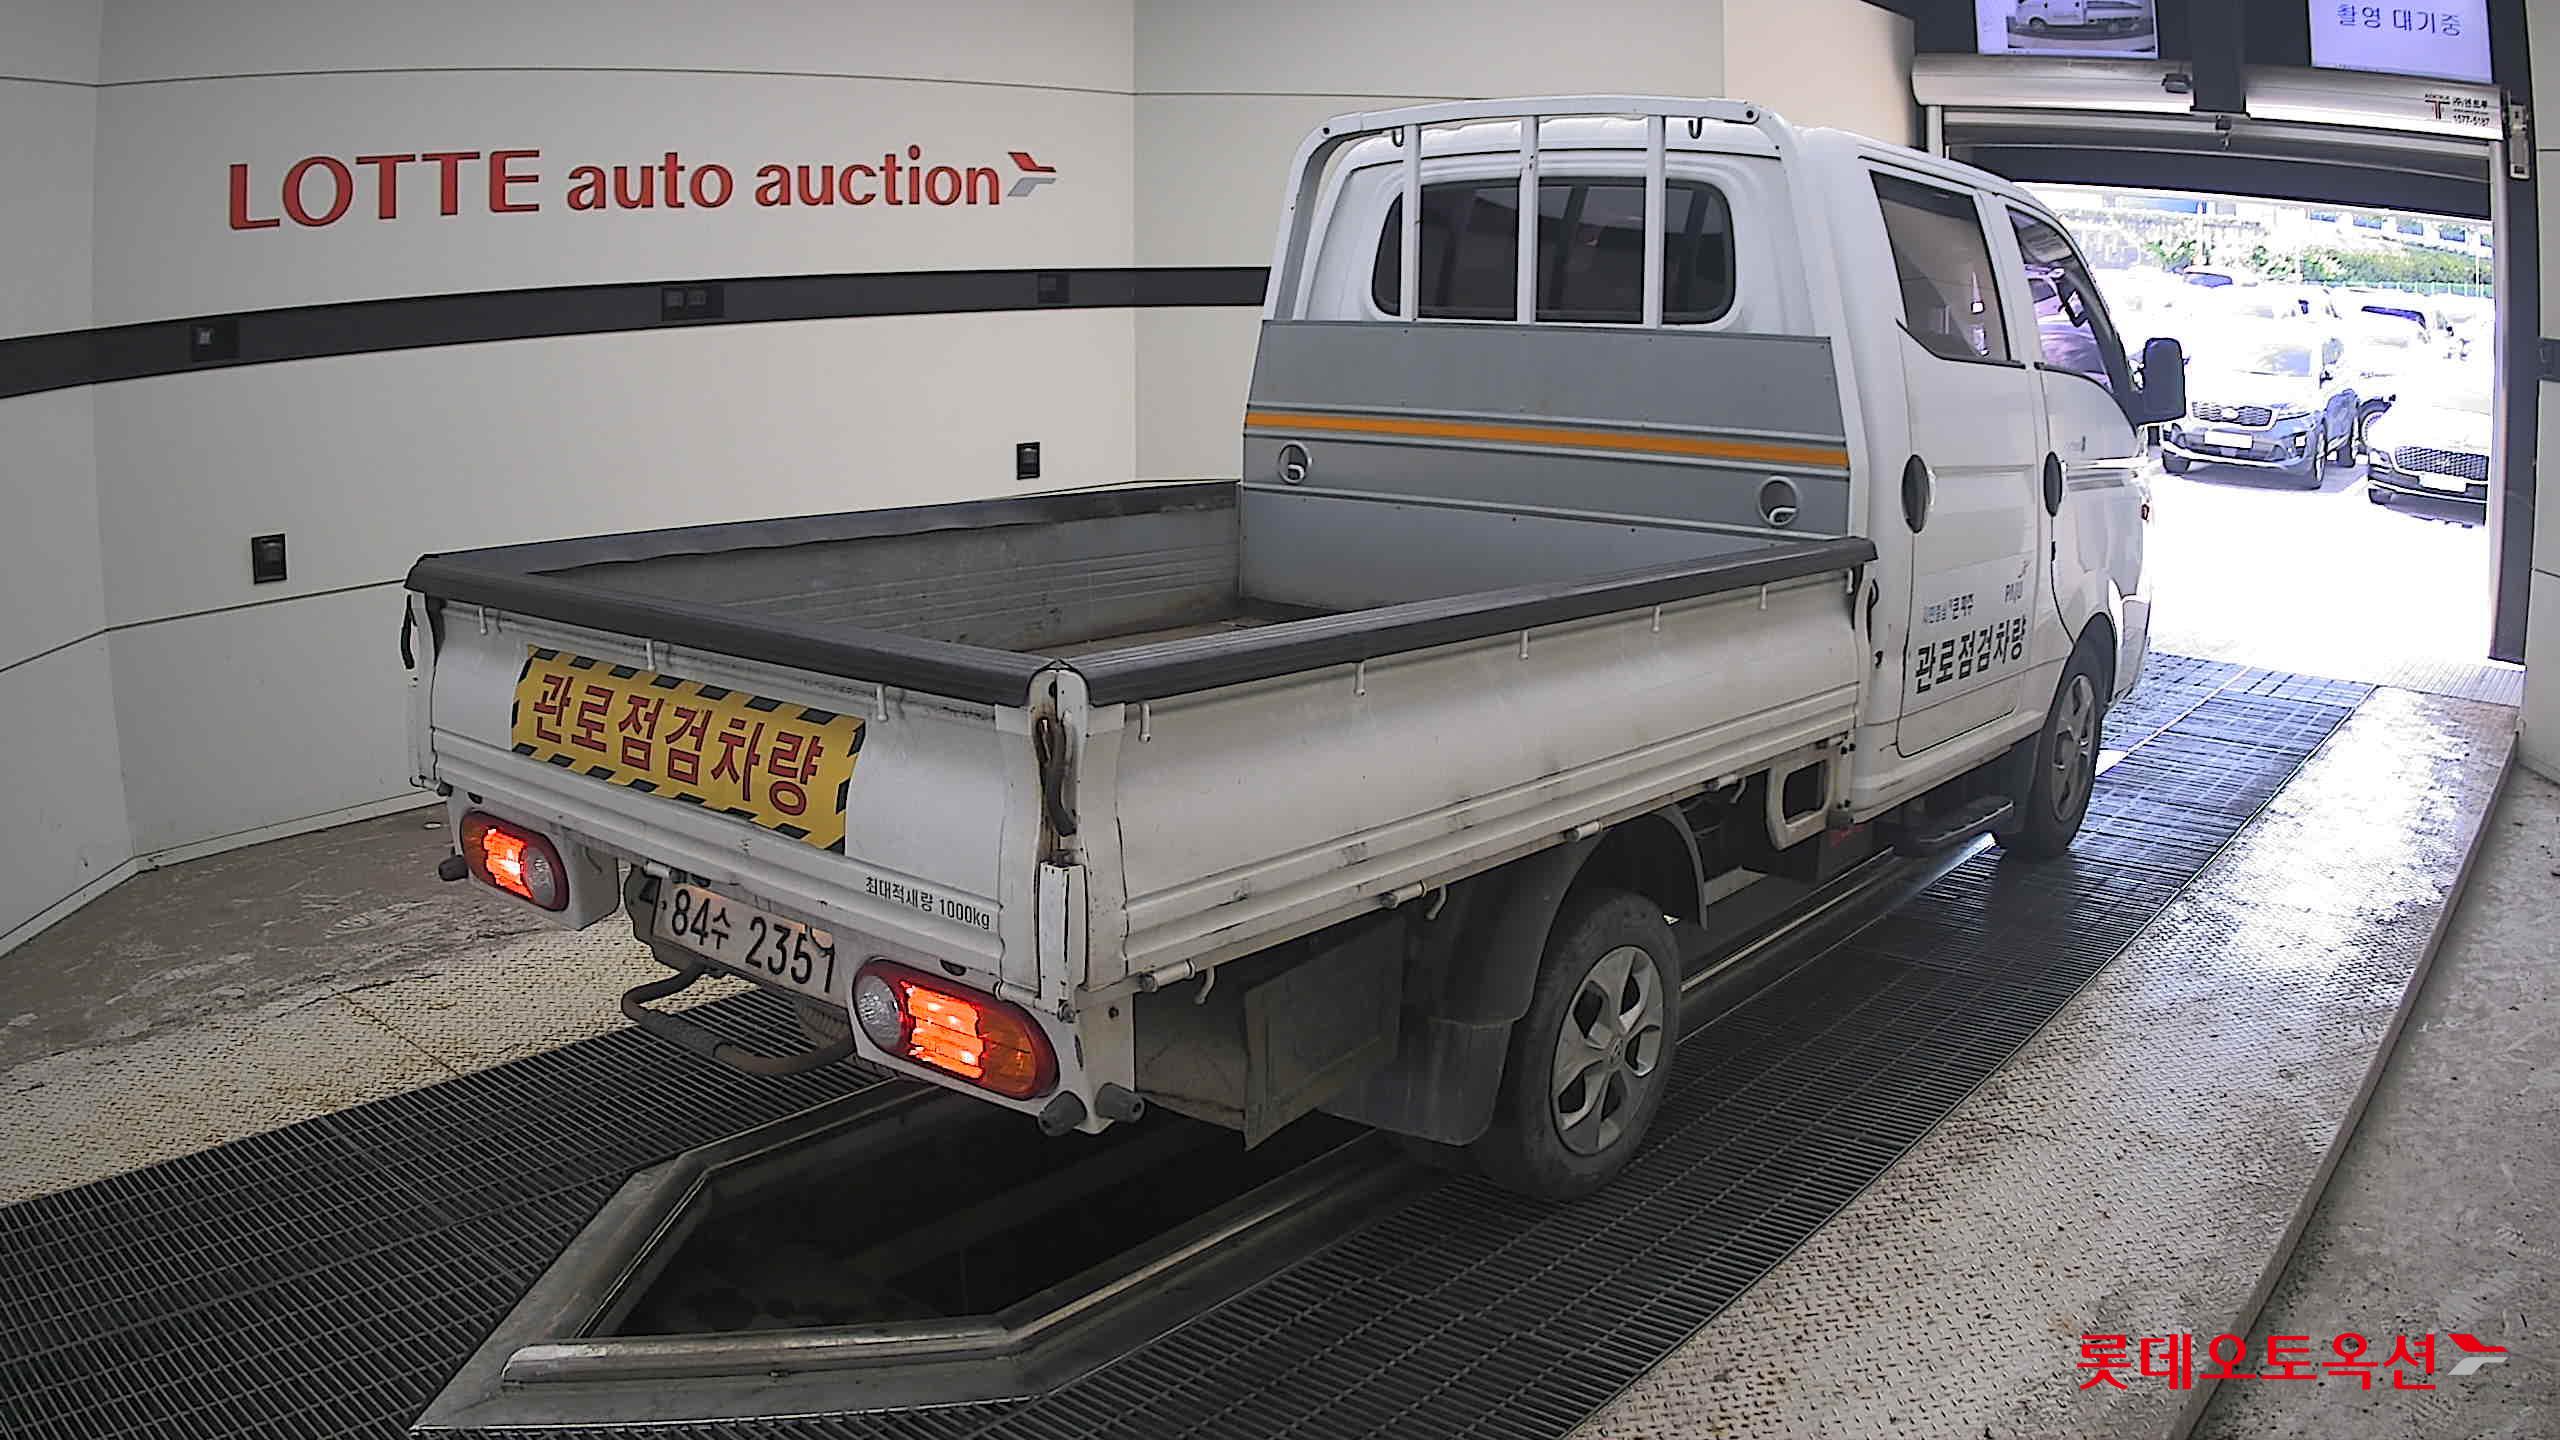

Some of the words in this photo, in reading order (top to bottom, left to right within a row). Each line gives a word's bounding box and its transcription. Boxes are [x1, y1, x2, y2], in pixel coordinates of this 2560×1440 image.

[2337, 4, 2381, 29] 촬영
[2392, 9, 2461, 37] 대기중
[229, 150, 540, 231] LOTTE
[566, 151, 734, 212] auto
[754, 144, 1000, 207] auction
[1915, 614, 2027, 695] 관로점검차량
[533, 673, 824, 816] 관로점검차량
[672, 888, 731, 950] 84수
[744, 916, 836, 994] 2351
[940, 898, 990, 930] 1000kg
